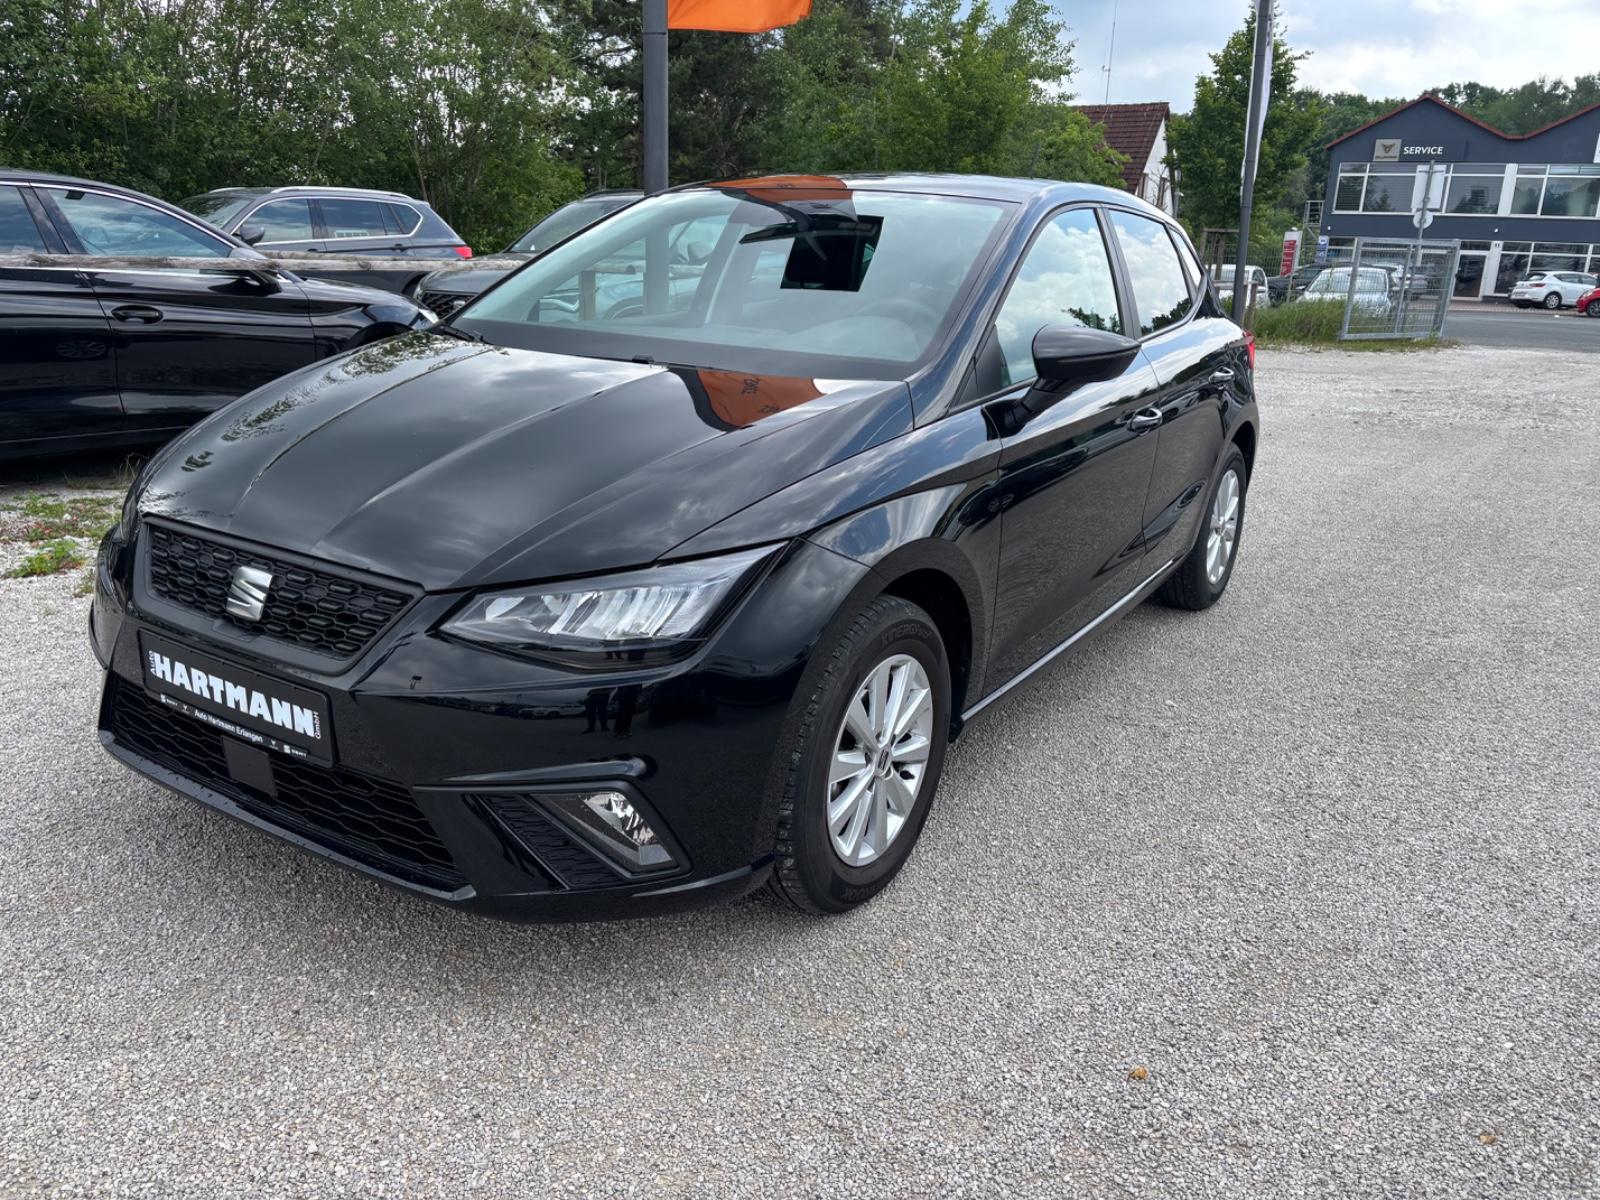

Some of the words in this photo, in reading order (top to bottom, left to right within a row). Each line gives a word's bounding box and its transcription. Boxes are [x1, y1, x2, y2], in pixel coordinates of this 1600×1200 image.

[1403, 146, 1445, 155] SERVICE
[148, 650, 157, 676] Auto
[153, 651, 316, 738] HARTMANN
[194, 709, 208, 721] Auto
[207, 714, 235, 733] Hartmann
[236, 726, 263, 743] Erlangen
[313, 711, 321, 740] GmbH
